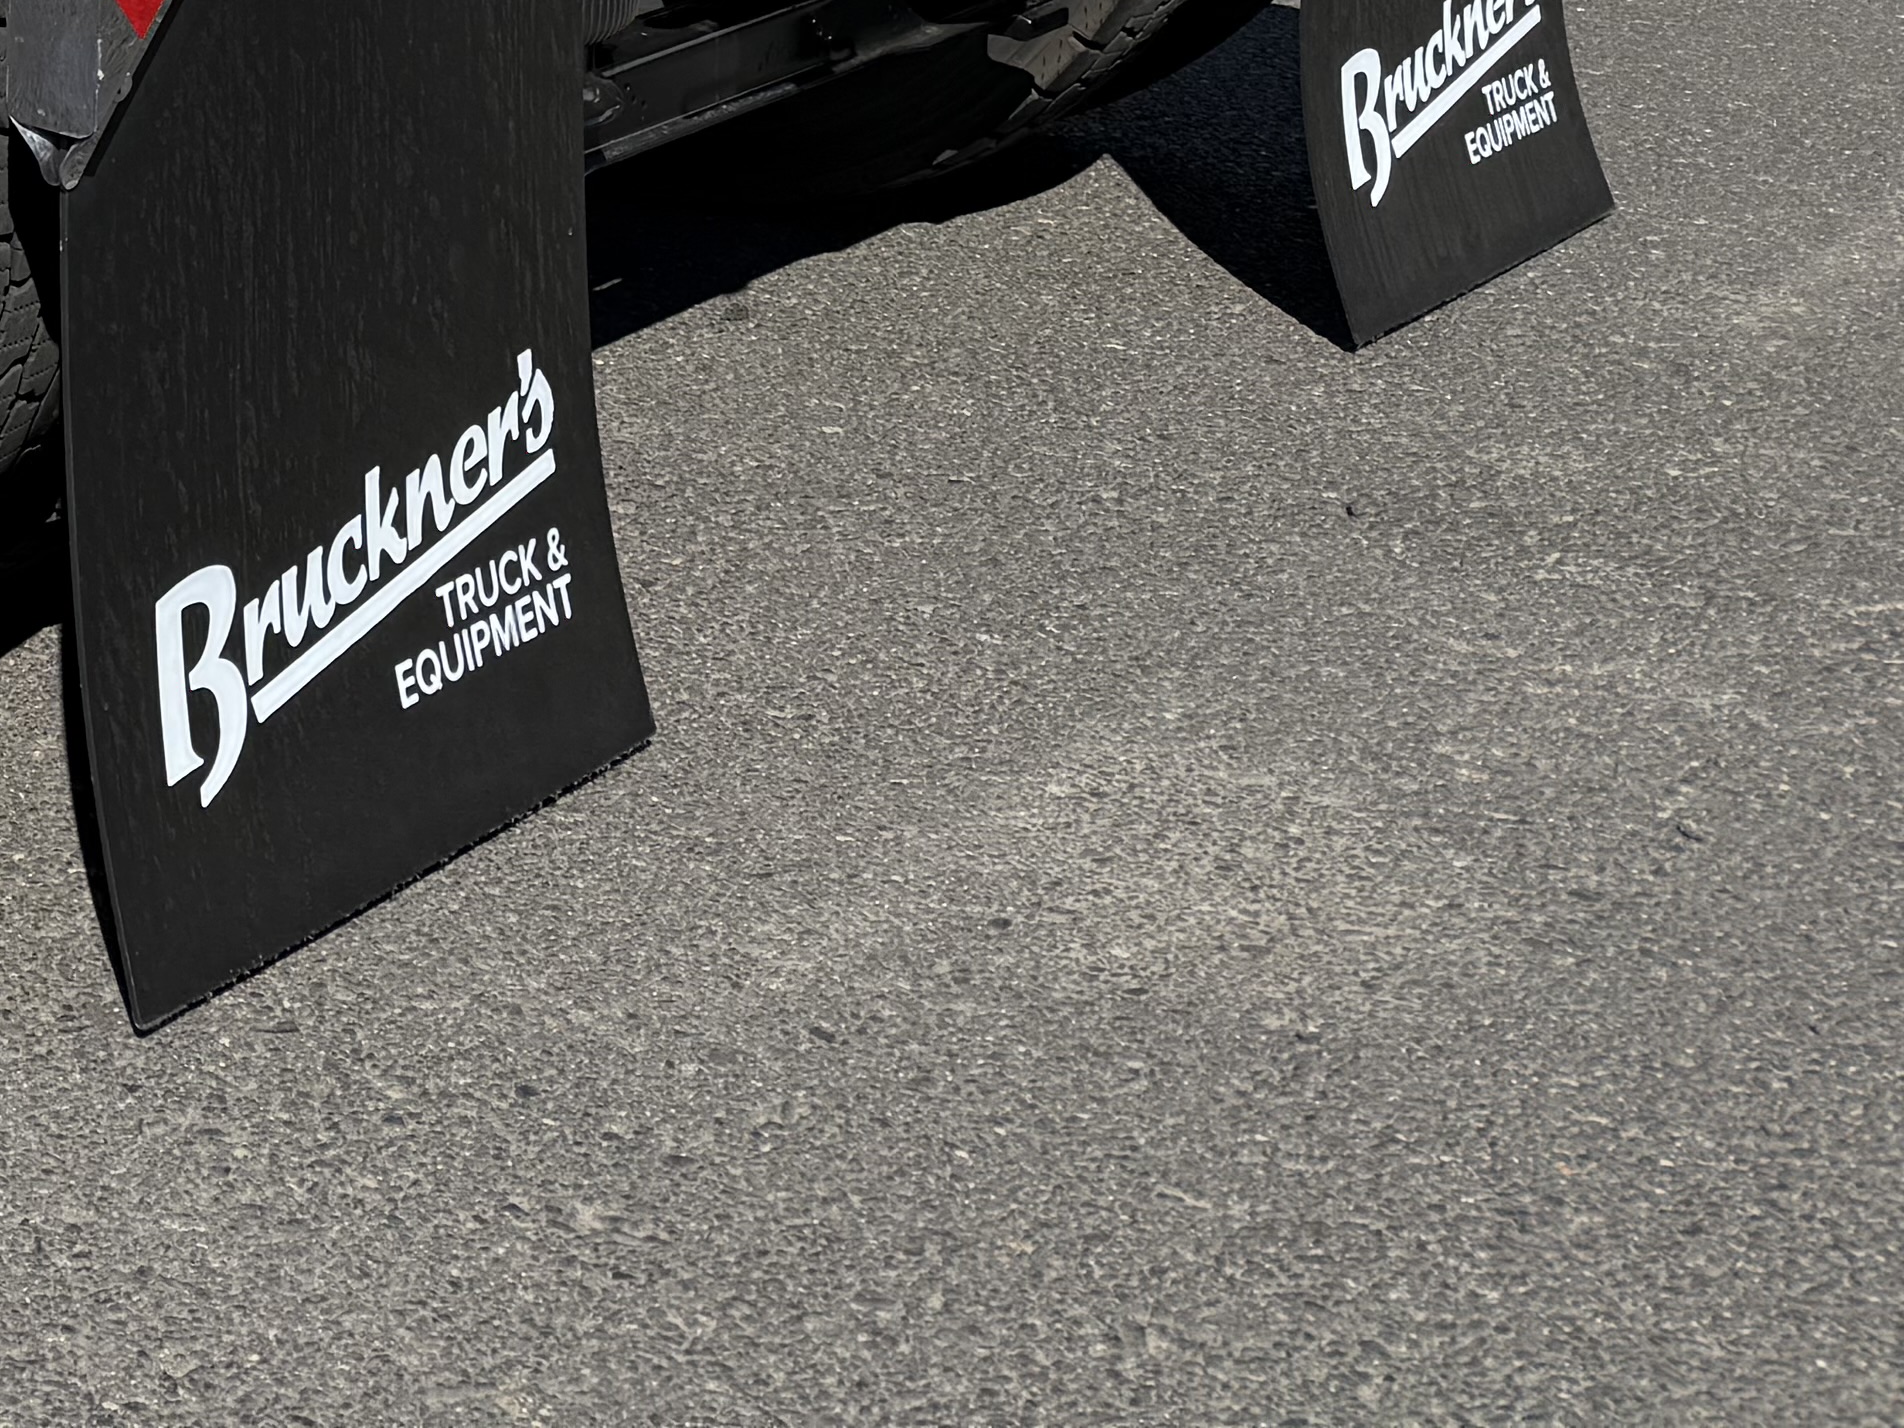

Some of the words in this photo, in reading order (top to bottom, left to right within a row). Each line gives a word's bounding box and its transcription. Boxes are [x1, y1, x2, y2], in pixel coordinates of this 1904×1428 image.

[1464, 91, 1559, 165] EQUIPMENT
[1482, 62, 1536, 115] TRUCK
[1538, 58, 1552, 88] &
[155, 348, 556, 808] Bruckner's
[435, 537, 542, 628] TRUCK
[545, 526, 569, 568] &
[394, 572, 573, 710] EQUIPMENT
